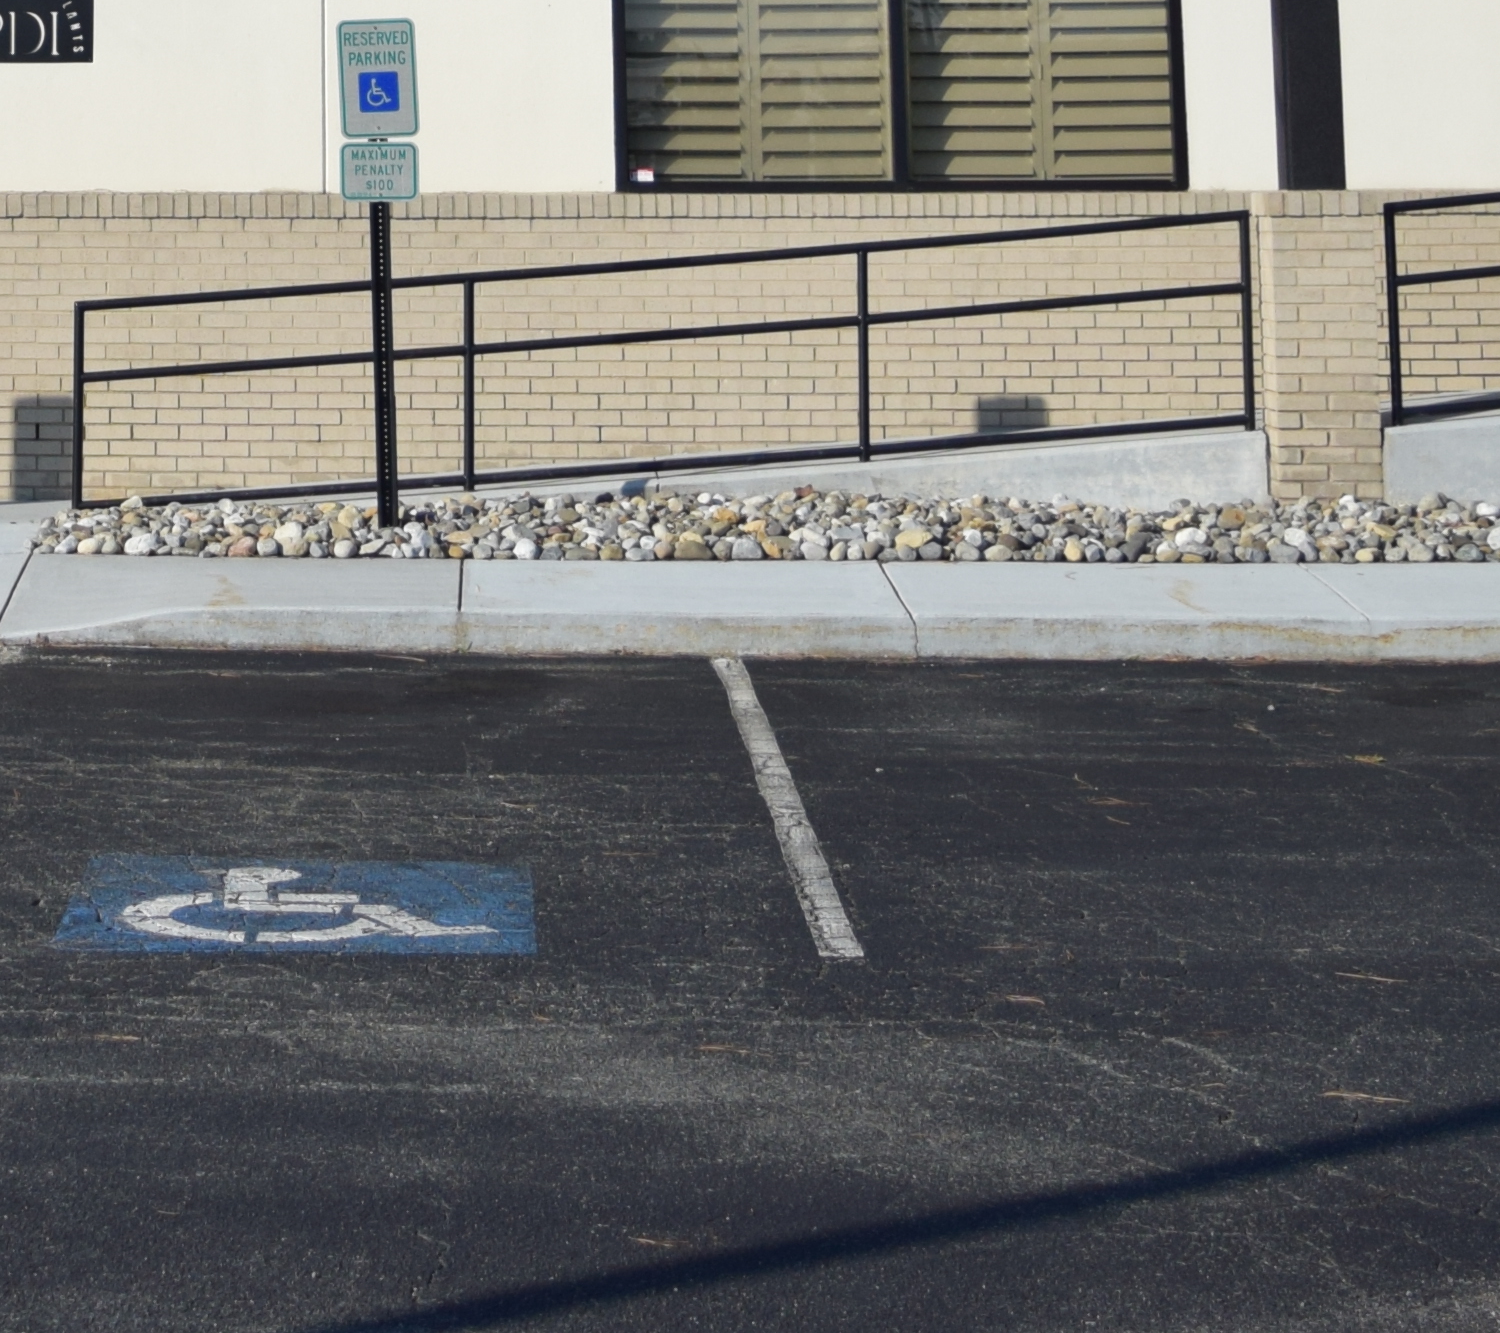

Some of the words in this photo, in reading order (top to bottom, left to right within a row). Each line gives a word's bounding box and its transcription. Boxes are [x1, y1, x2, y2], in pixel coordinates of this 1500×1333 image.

[343, 31, 409, 46] RESERVED
[348, 50, 406, 66] PARKING
[351, 149, 406, 161] MAXIMUM
[354, 164, 404, 176] PENALTY
